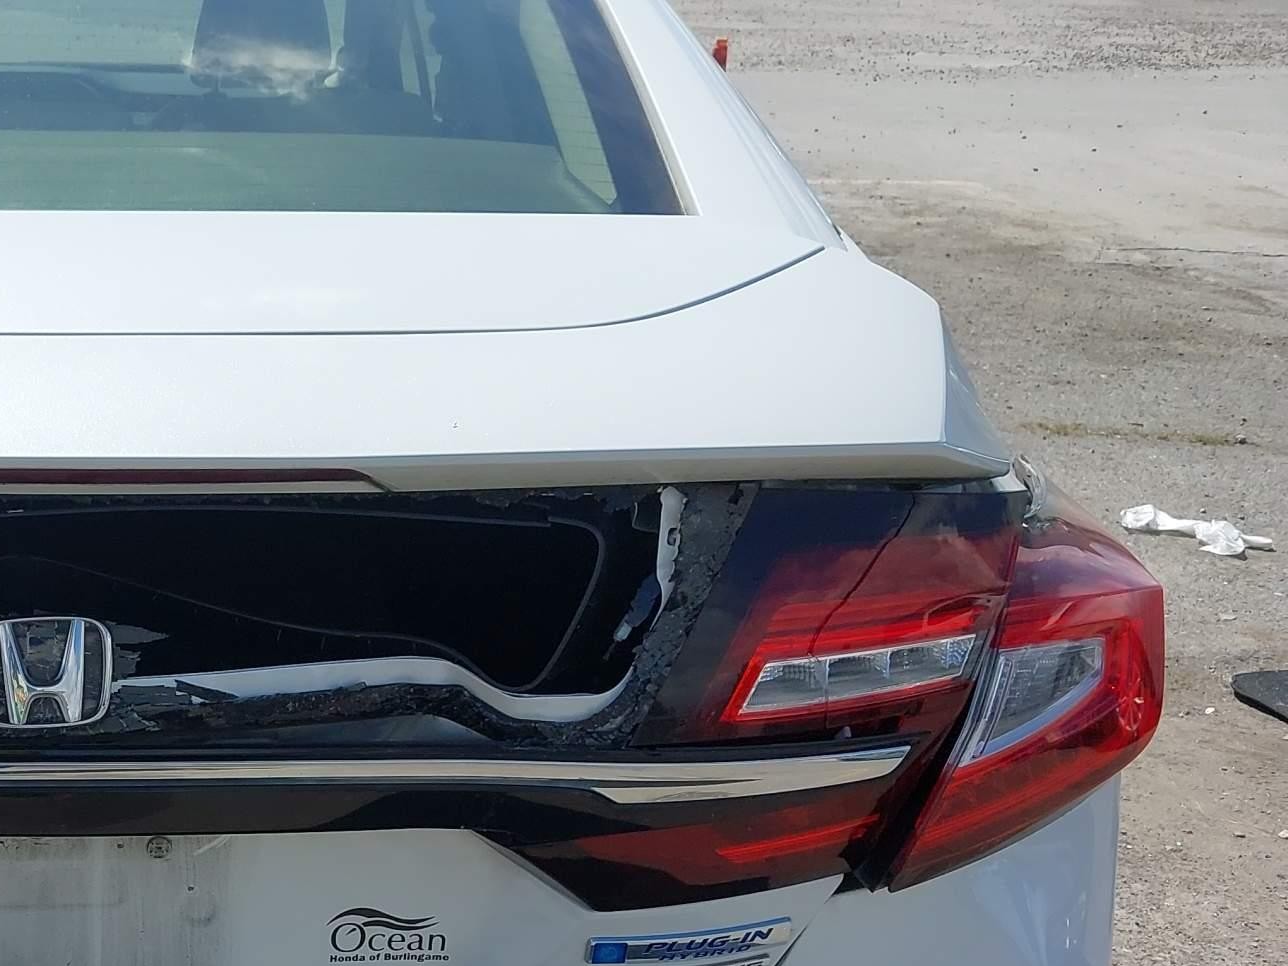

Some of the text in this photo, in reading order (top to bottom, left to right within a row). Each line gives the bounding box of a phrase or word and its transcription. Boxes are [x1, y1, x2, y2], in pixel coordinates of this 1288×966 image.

[330, 922, 447, 953] Ocean
[642, 927, 774, 953] PLUG-IN
[329, 952, 450, 963] Honda of Burlingame
[658, 944, 752, 961] HYBRID
